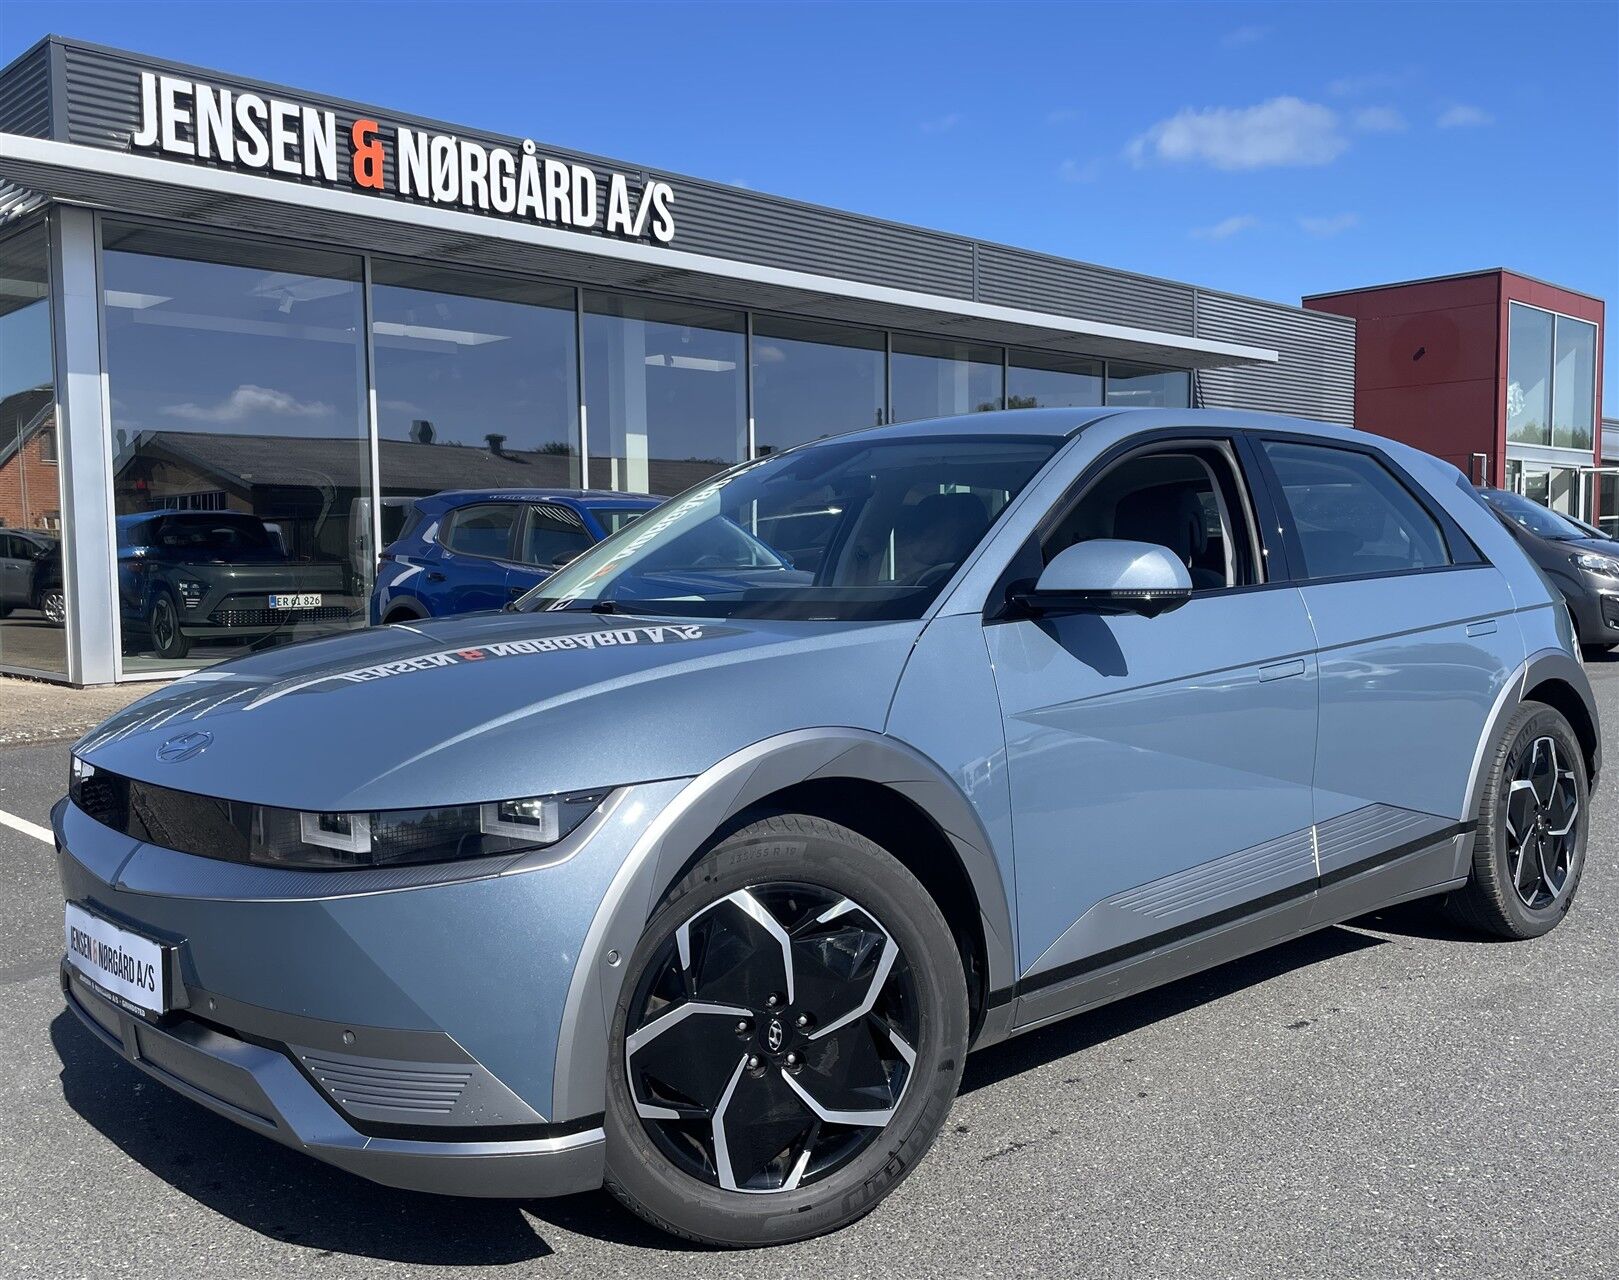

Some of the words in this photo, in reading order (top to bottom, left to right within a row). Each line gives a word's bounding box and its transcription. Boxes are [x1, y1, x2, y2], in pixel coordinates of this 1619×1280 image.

[133, 72, 338, 182] JENSEN
[352, 119, 385, 190] &
[397, 127, 598, 228] NØRGÅRD
[606, 173, 675, 243] A/S
[277, 597, 289, 606] ER
[303, 596, 320, 606] 826
[70, 925, 92, 962] JENSEN
[92, 940, 98, 965] &
[98, 941, 135, 984] NØRGÅRD
[136, 960, 155, 992] A/S
